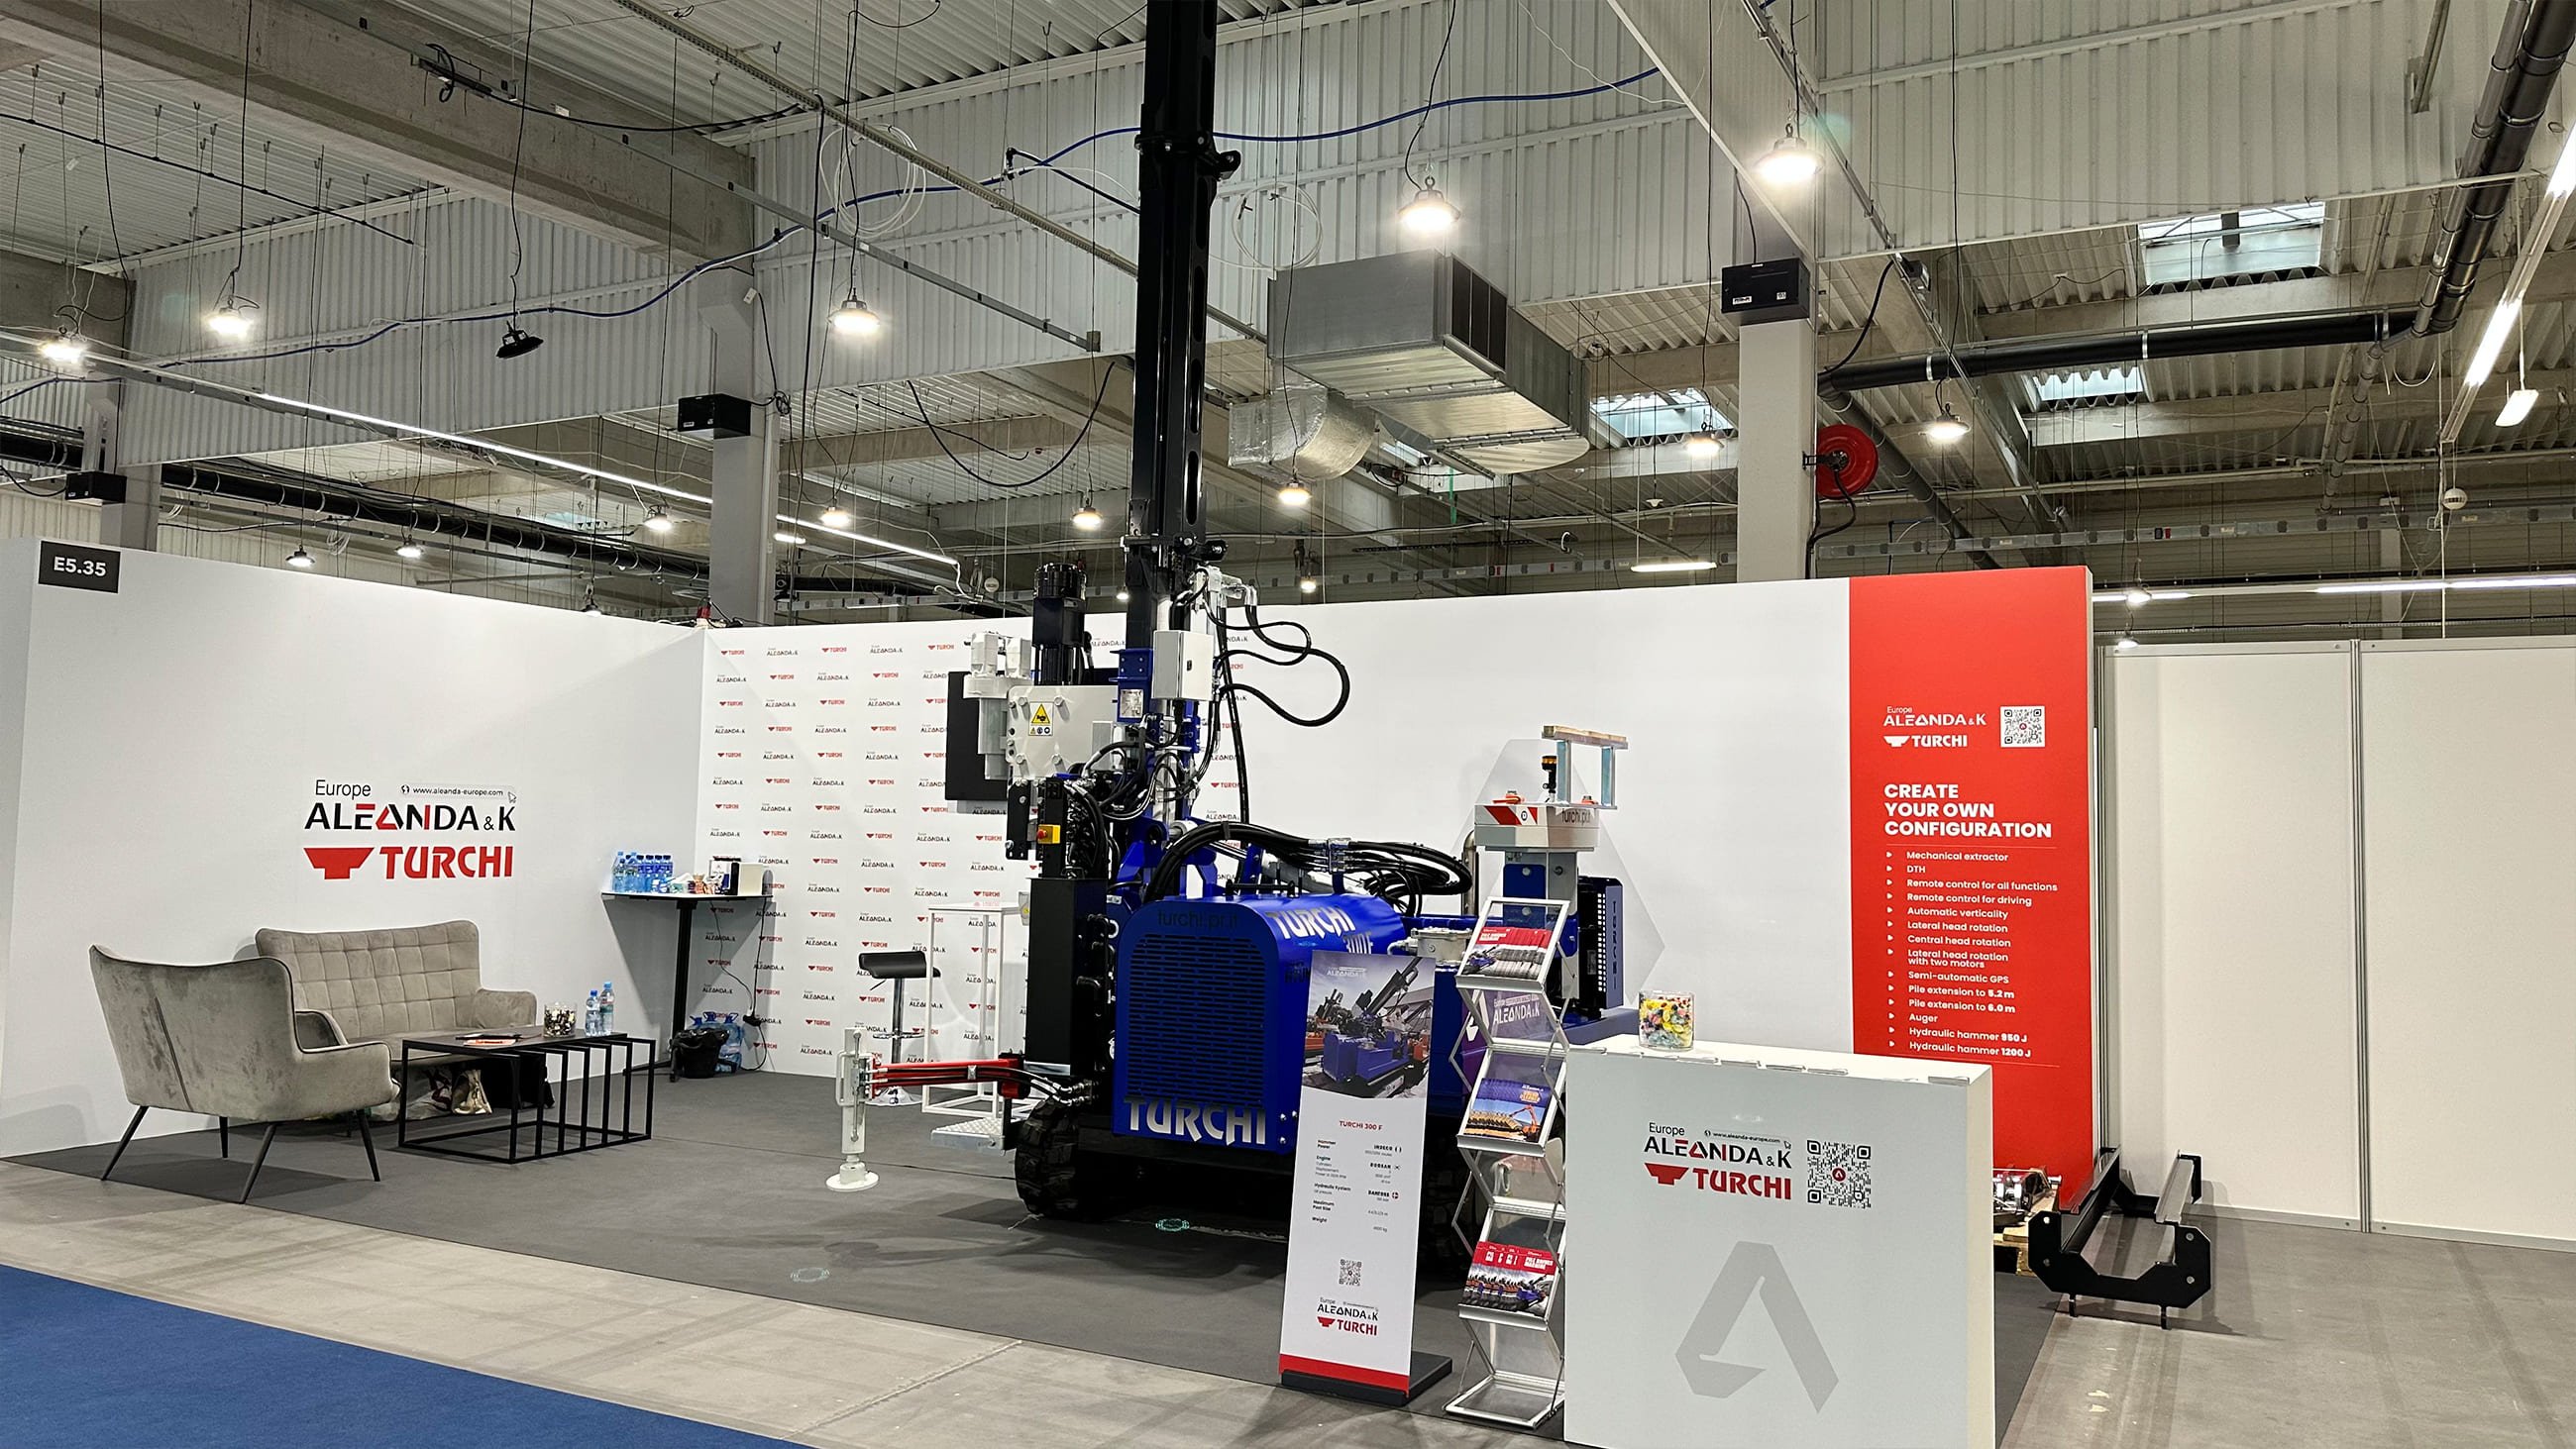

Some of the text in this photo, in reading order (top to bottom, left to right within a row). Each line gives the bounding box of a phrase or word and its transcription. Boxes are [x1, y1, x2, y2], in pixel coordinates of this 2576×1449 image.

[54, 557, 105, 576] E5.35
[1883, 714, 1967, 726] ALEANDA
[1977, 714, 1986, 725] K
[1911, 735, 1967, 747] TURCHI
[316, 779, 371, 800] Europe
[1884, 784, 1958, 798] CREATE
[305, 802, 515, 831] ALEANDA & K
[1884, 802, 1993, 817] YOUR OWN
[1885, 821, 2051, 837] CONFIGURATION
[379, 846, 513, 880] TURCHI
[2011, 881, 2057, 890] functions
[1997, 896, 2031, 907] driving
[1908, 907, 2008, 920] Automatic verticality
[1266, 905, 1355, 940] TURCHI
[1908, 949, 1940, 959] Lateral
[1908, 972, 1987, 983] Semi-automatic
[1927, 987, 1974, 996] extension
[1909, 998, 1925, 1007] Pile
[1927, 1001, 1974, 1010] extension
[1909, 1014, 1938, 1024] Auger
[1910, 1028, 1954, 1037] Hydraulic
[1958, 1030, 1999, 1040] hammer
[1910, 1042, 1955, 1052] Hydraulic
[1958, 1045, 1999, 1055] hammer
[1124, 1095, 1266, 1145] TURCHI
[1340, 1120, 1363, 1129] TURCHI
[1650, 1122, 1684, 1137] Europe
[1645, 1136, 1791, 1169] ALEANDA & K
[1692, 1168, 1791, 1199] TURCHI
[1317, 1303, 1366, 1319] ALEANDA
[1337, 1319, 1377, 1336] TURCHI
